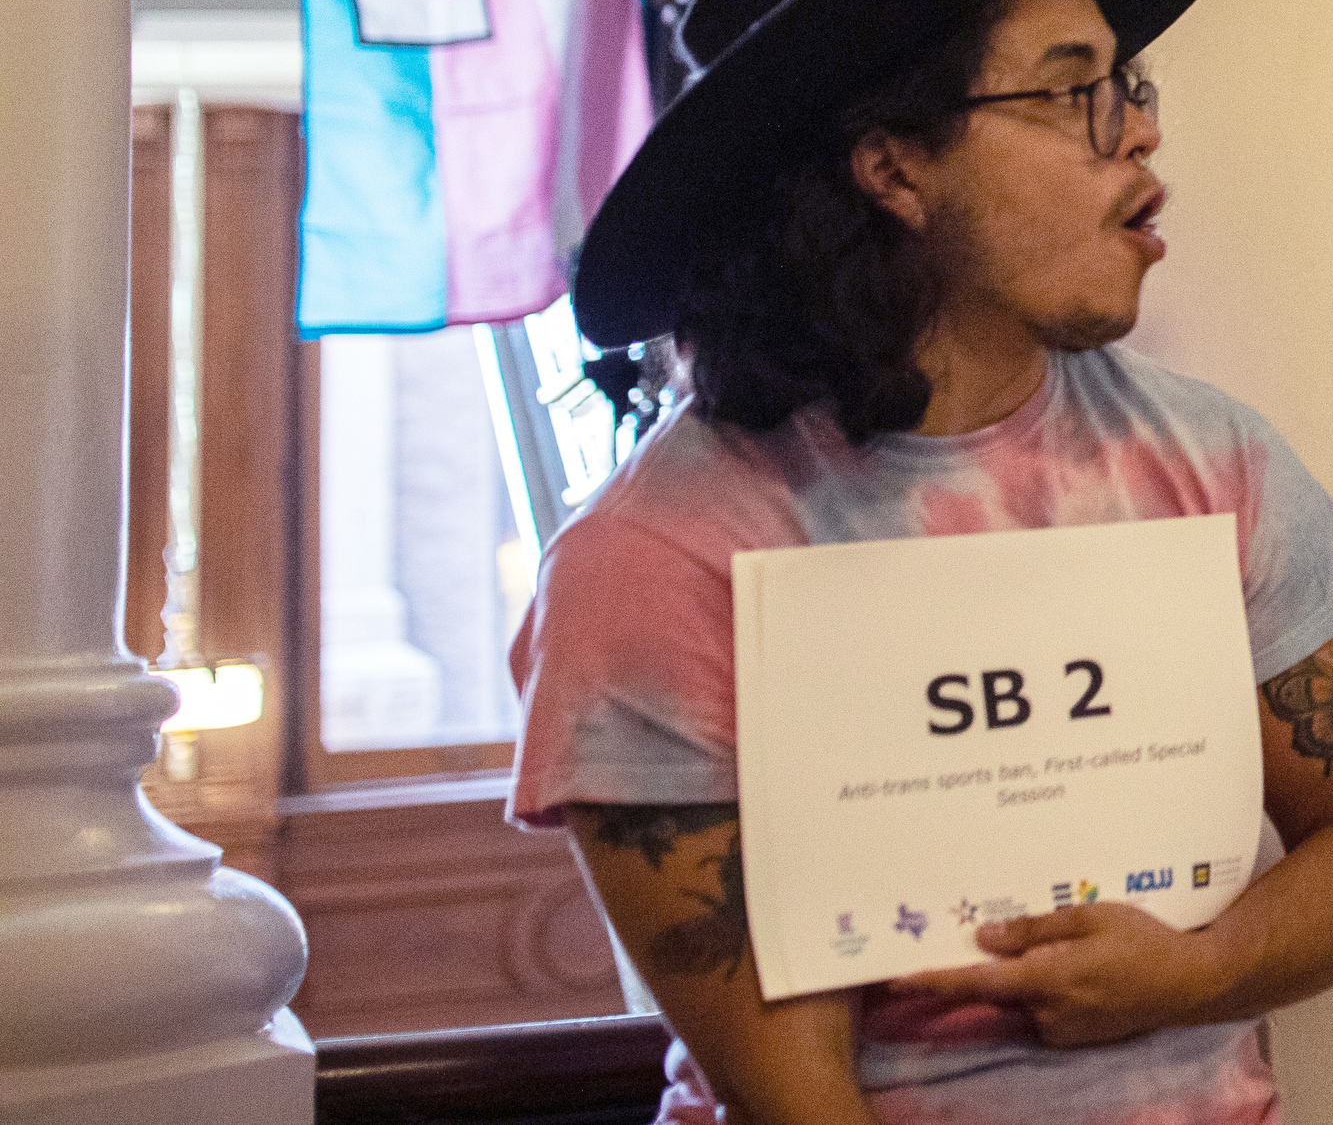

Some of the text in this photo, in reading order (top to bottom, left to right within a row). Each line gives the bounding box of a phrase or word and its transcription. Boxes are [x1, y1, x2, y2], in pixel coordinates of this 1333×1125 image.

[926, 659, 1112, 735] SB 2
[997, 784, 1066, 807] Session
[1125, 868, 1172, 893] ACLU
